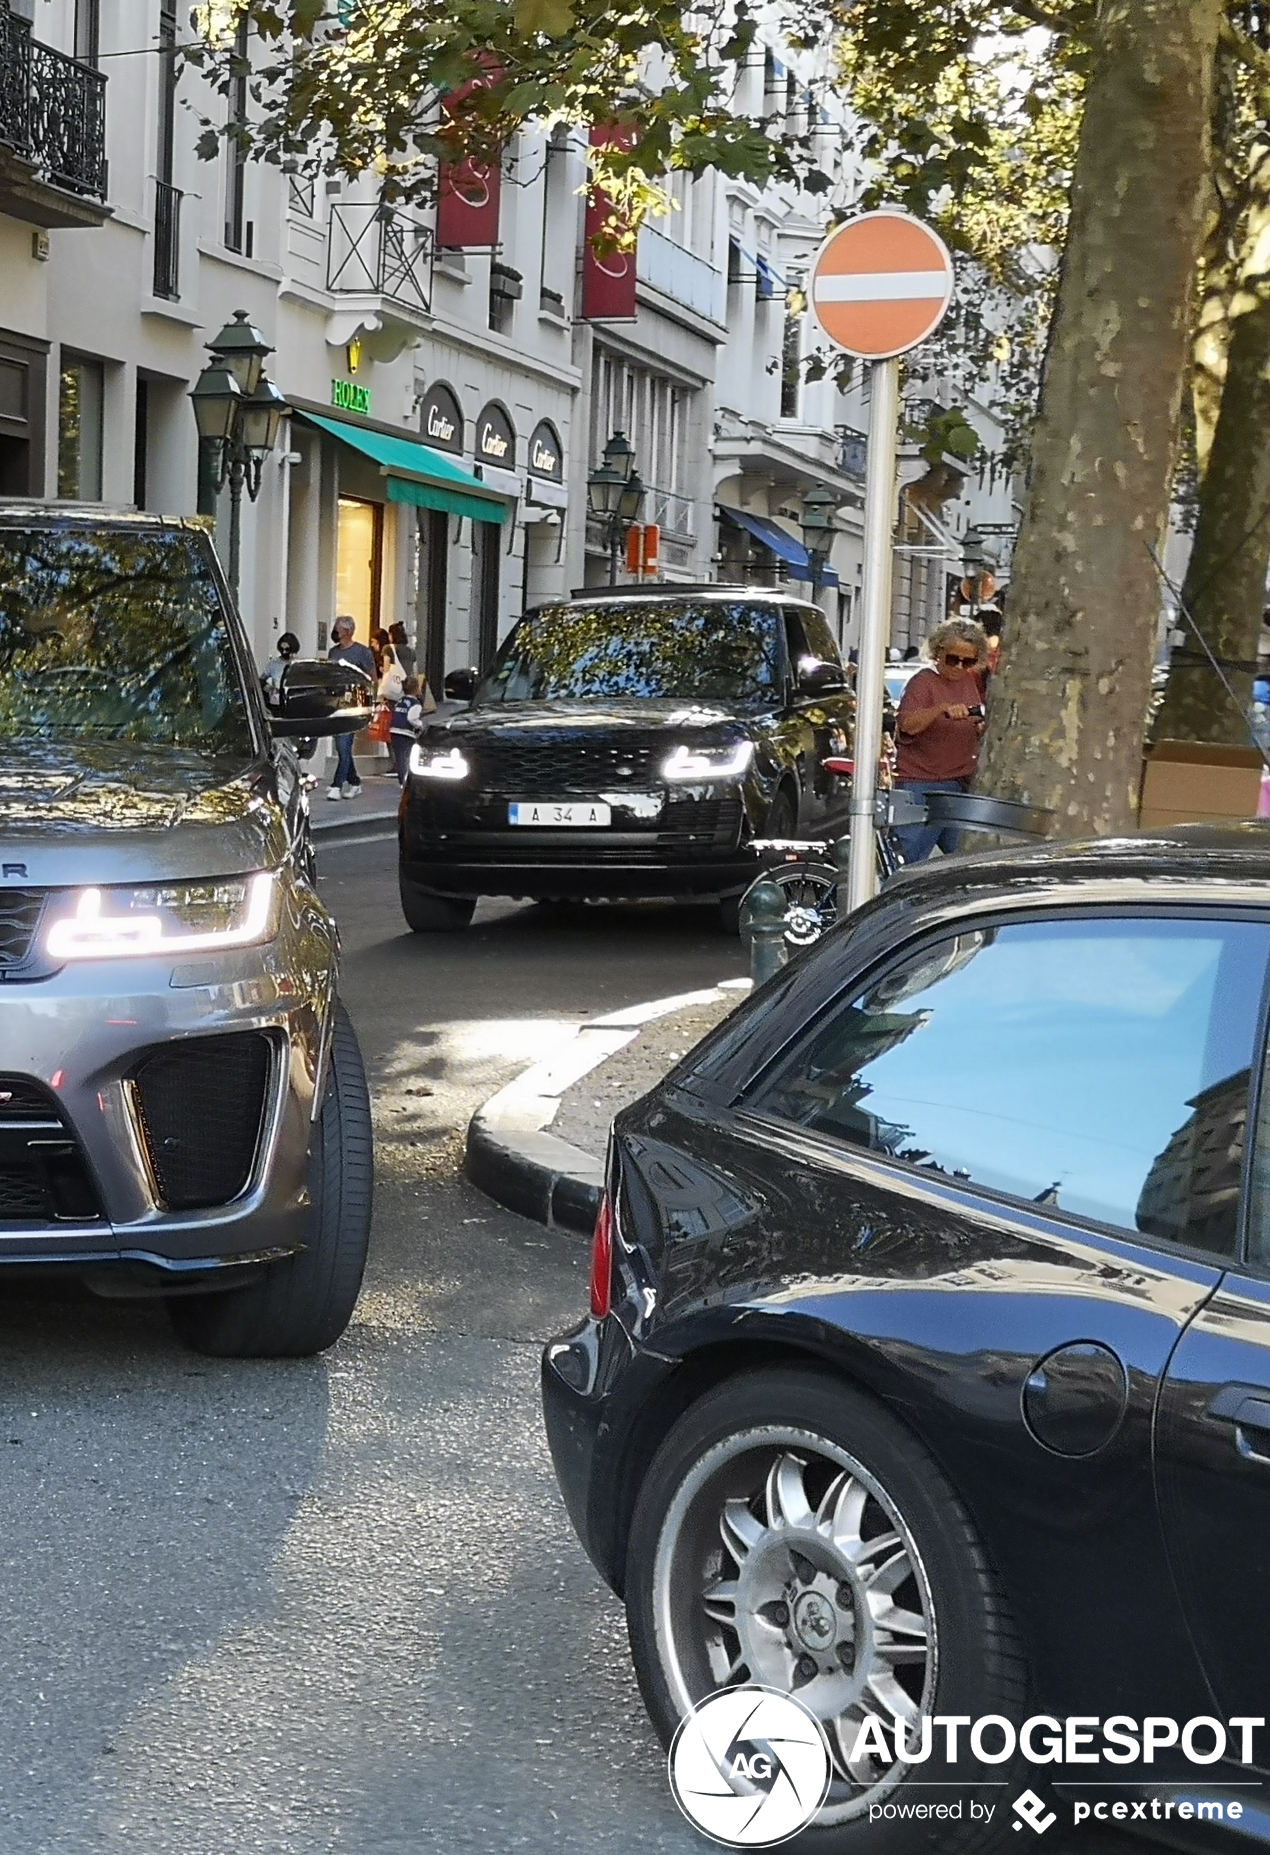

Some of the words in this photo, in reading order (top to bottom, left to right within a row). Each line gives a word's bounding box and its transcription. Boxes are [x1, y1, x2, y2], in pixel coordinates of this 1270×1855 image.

[332, 378, 371, 413] ROLEX
[531, 807, 540, 822] A
[553, 807, 573, 822] 34
[589, 807, 598, 822] A
